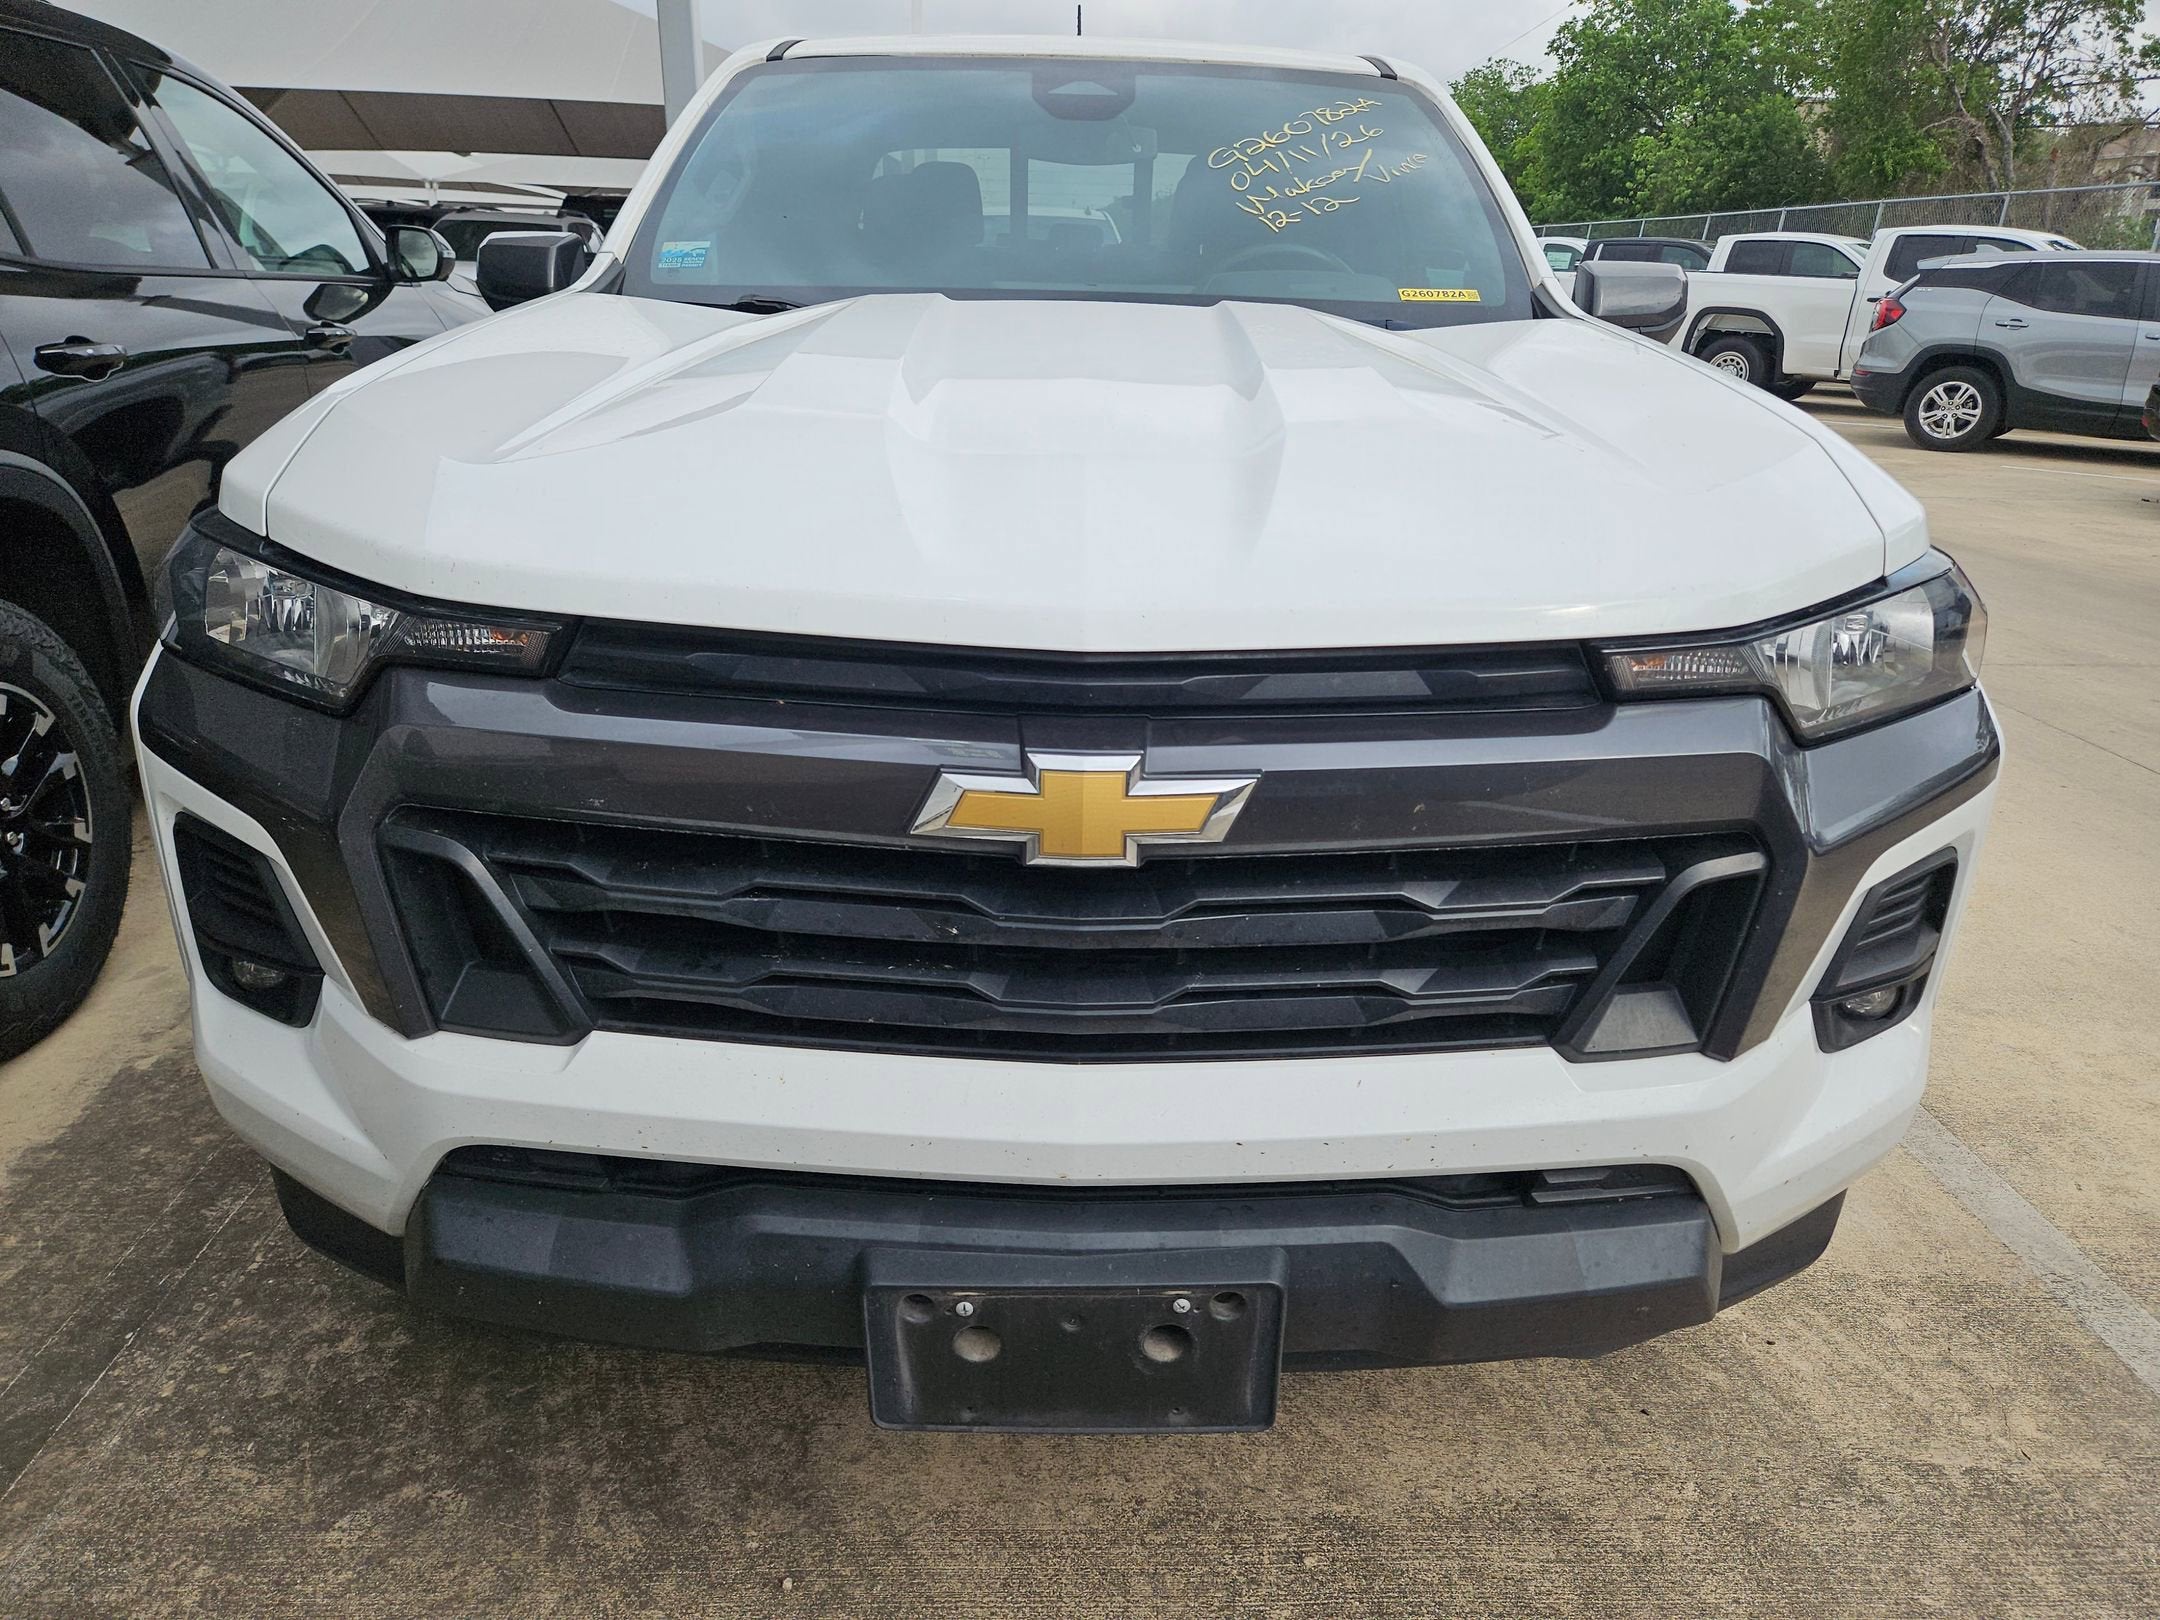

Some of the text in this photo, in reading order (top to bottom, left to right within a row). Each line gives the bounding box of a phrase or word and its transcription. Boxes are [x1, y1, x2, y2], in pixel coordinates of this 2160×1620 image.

[1230, 123, 1384, 191] 04/11/26
[1258, 196, 1361, 233] 12-12
[1401, 289, 1467, 298] G260782A
